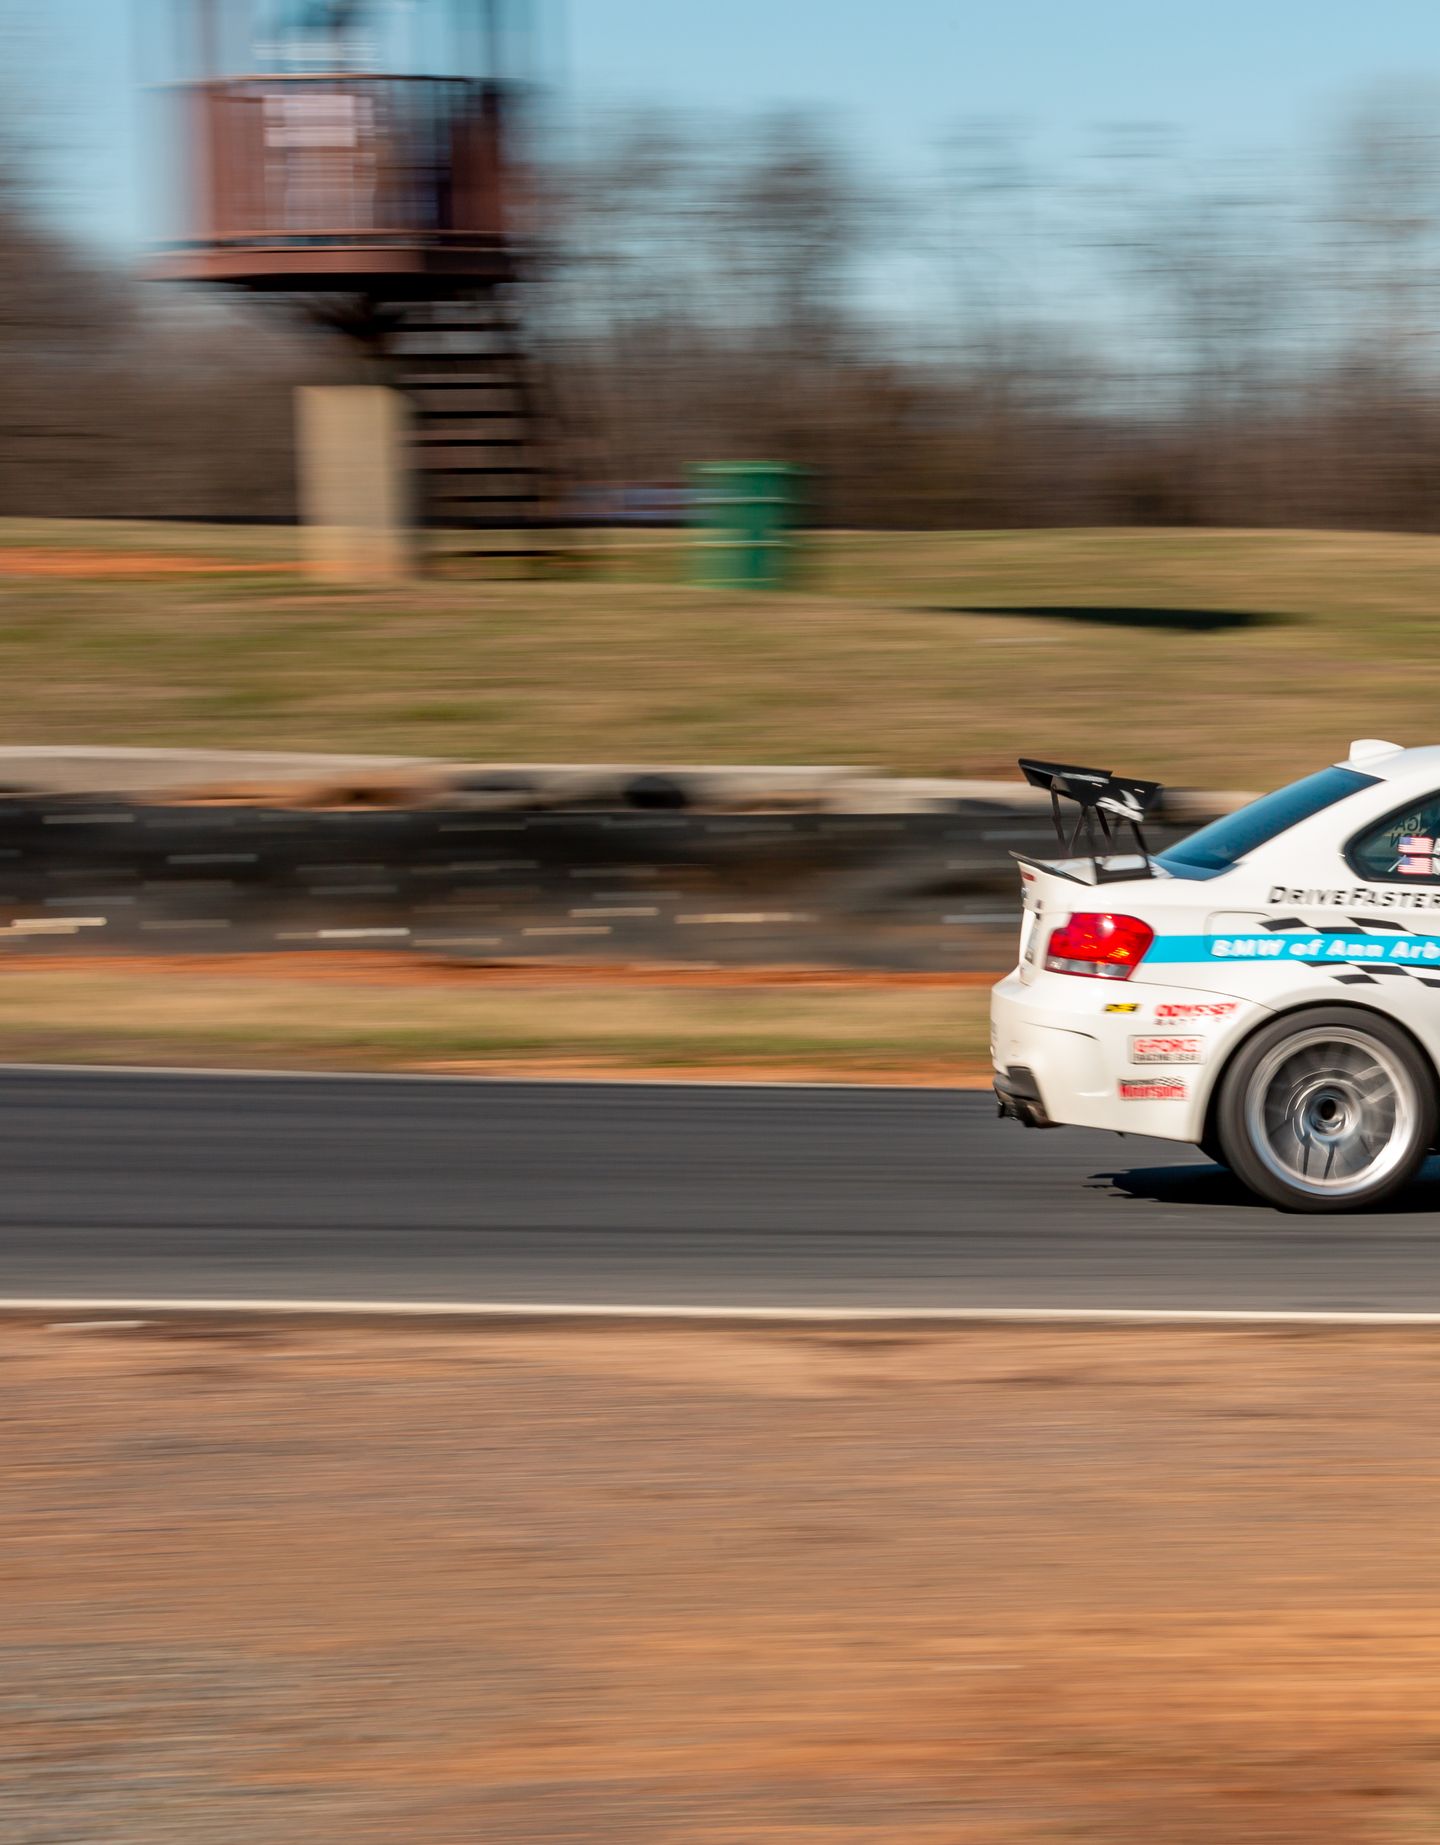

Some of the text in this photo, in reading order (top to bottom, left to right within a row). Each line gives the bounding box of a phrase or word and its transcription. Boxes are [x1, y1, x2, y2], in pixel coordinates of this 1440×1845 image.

[1211, 939, 1286, 957] BMW
[1289, 938, 1324, 957] of
[1326, 939, 1385, 957] Ann
